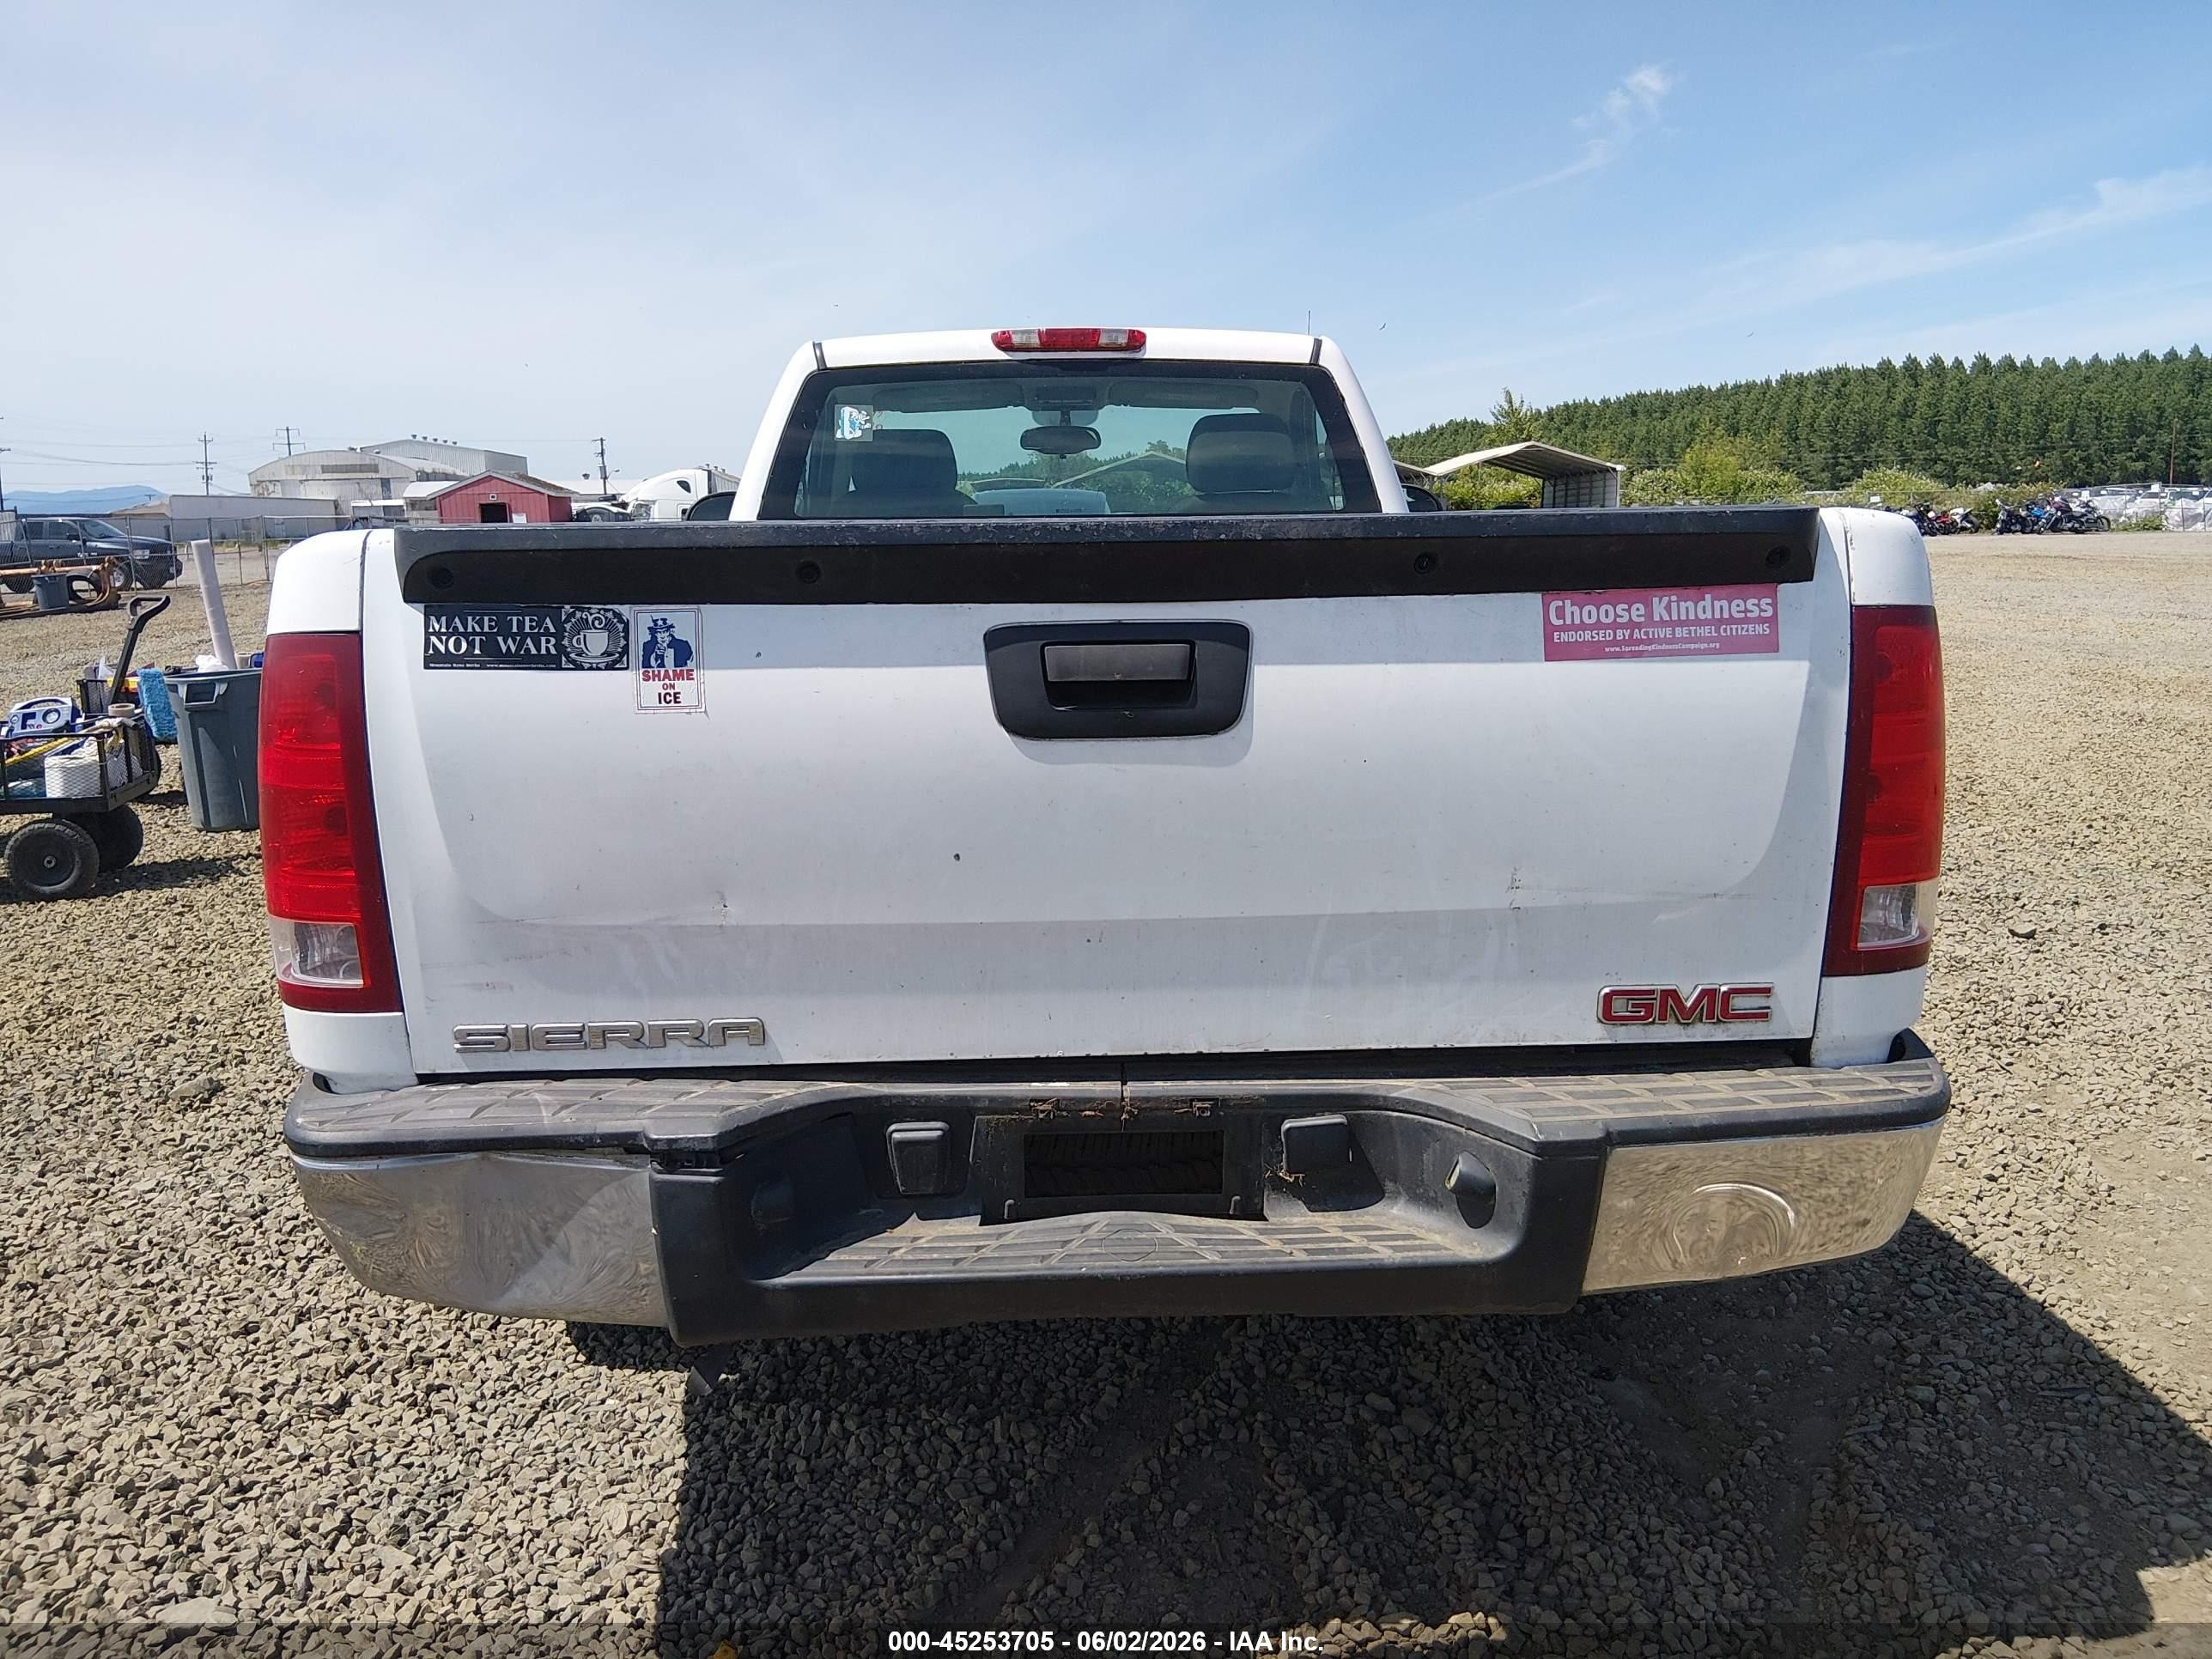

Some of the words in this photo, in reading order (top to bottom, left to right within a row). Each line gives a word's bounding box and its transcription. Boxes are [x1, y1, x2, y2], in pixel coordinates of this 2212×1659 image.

[1549, 598, 1645, 626] Choose
[1652, 593, 1773, 621] Kindness
[428, 616, 499, 634] MAKE
[507, 616, 556, 633] TEA
[1553, 628, 1613, 642] ENDORSED
[1616, 629, 1631, 640] BY
[1633, 627, 1673, 640] ACTIVE
[1675, 626, 1717, 637] BETHEL
[1720, 623, 1770, 636] CITIZENS
[428, 636, 486, 654] NOT
[497, 636, 557, 654] WAR
[641, 669, 695, 682] SHAME
[658, 692, 682, 704] ICE
[1597, 983, 1774, 1024] GMC
[453, 1017, 766, 1053] SIERRA
